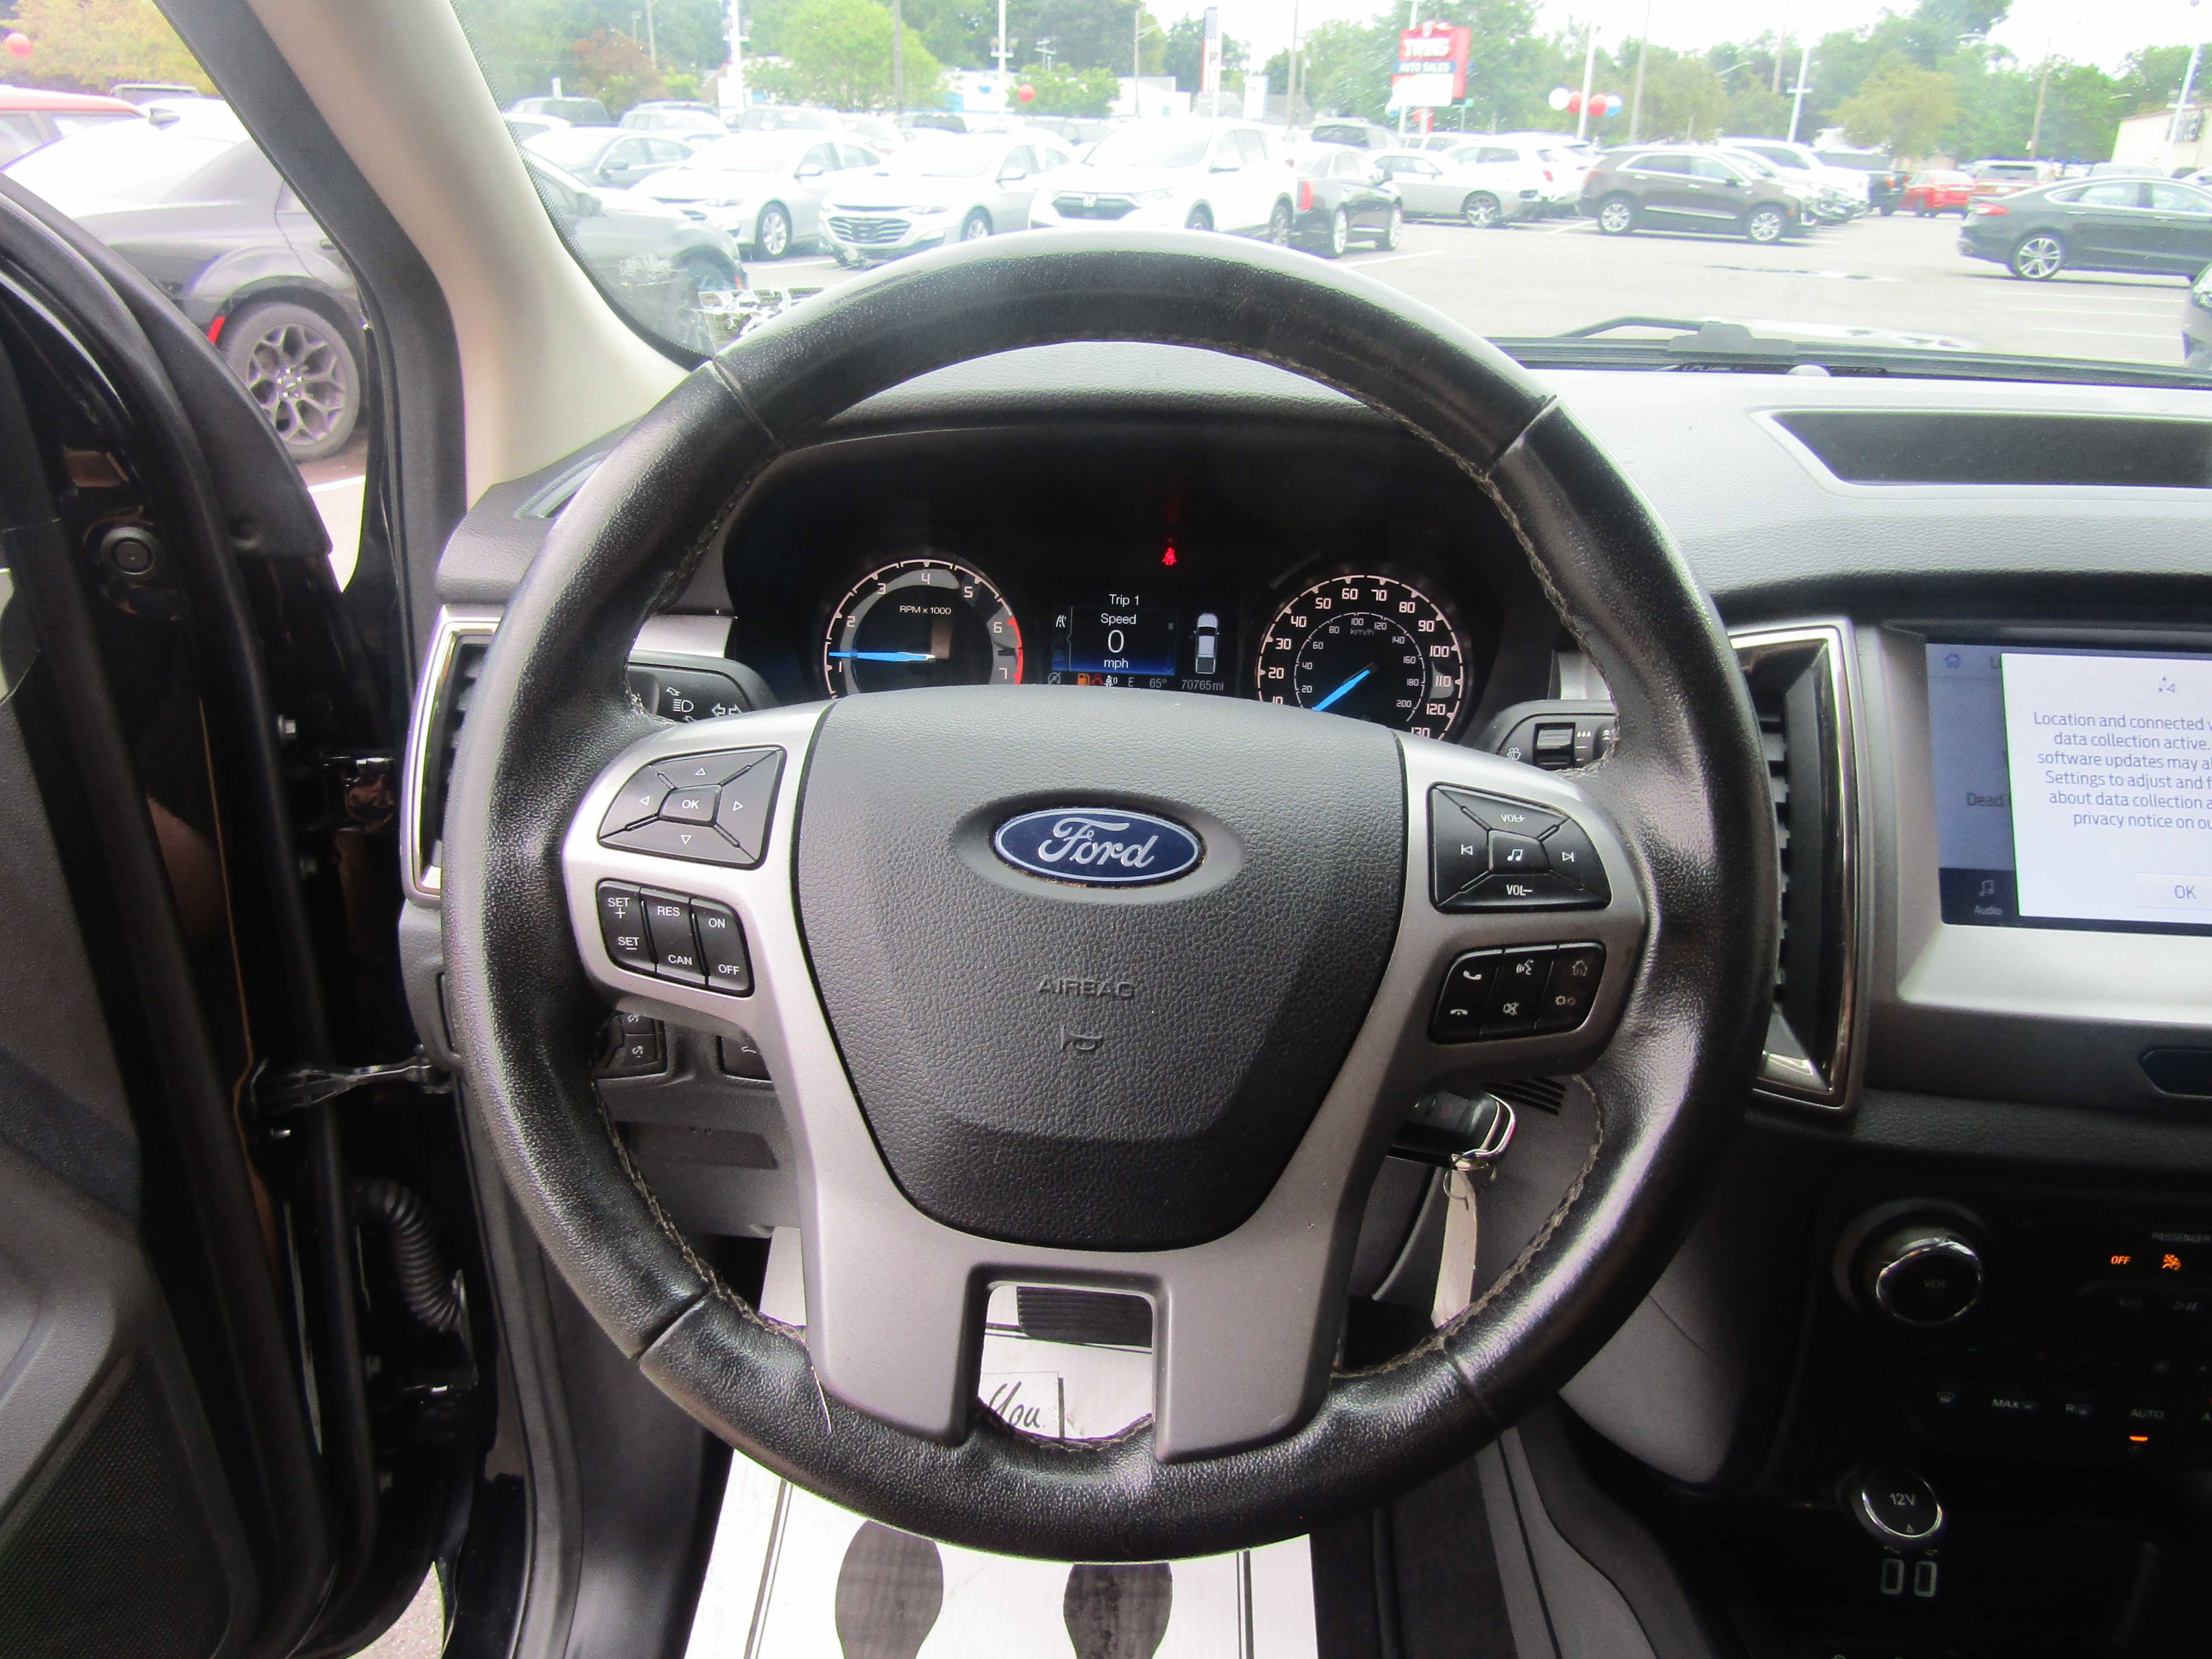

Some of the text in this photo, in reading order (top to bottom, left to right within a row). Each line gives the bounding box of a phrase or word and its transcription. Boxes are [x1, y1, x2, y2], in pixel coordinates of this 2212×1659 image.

[922, 573, 930, 585] 4
[877, 583, 886, 595] 3
[964, 586, 973, 598] 5
[1342, 588, 1358, 600] 60
[1371, 589, 1387, 601] 70
[1109, 594, 1139, 607] Trip 1
[1315, 598, 1331, 610] 50
[900, 605, 921, 614] RPM
[930, 607, 951, 615] 1000
[1399, 602, 1415, 614] 80
[846, 616, 855, 627] 2
[1100, 613, 1136, 626] Speed
[1291, 616, 1307, 628] 40
[994, 622, 1002, 633] 6
[1350, 628, 1374, 636] km/h
[1418, 620, 1435, 632] 90
[1108, 629, 1124, 653] 0
[1275, 638, 1291, 650] 30
[1429, 645, 1449, 657] 100
[839, 661, 842, 673] 1
[1104, 658, 1128, 670] mph
[999, 668, 1008, 679] 7
[1268, 667, 1284, 679] 20
[1128, 678, 1134, 687] E
[1435, 675, 1451, 687] 110
[1426, 703, 1446, 715] 120
[2033, 711, 2096, 726] Location
[2099, 714, 2126, 728] and
[2130, 717, 2203, 731] connected
[1411, 727, 1430, 738] 130
[2054, 732, 2211, 750] data collection active.
[2038, 751, 2102, 766] software
[2105, 754, 2164, 769] updates
[2167, 758, 2198, 772] may
[2045, 771, 2106, 788] Settings
[2109, 774, 2124, 787] to
[2127, 775, 2172, 791] adjust
[2176, 776, 2203, 790] and
[682, 799, 700, 810] OK
[1966, 793, 2004, 807] Dead
[2049, 791, 2092, 805] about
[2095, 793, 2129, 807] data
[2133, 794, 2203, 809] collection
[2073, 813, 2124, 829] privacy
[2128, 814, 2172, 829] notice
[2176, 817, 2194, 829] on
[1038, 817, 1158, 868] Ford
[2174, 885, 2197, 899] OK
[608, 897, 630, 908] SET
[657, 906, 681, 917] RES
[708, 918, 725, 929] ON
[618, 936, 639, 946] SET
[668, 954, 693, 966] CAN
[718, 964, 740, 975] OFF
[1037, 977, 1135, 1000] AIRBAG
[2110, 1255, 2132, 1265] OFF
[988, 1381, 1040, 1428] You
[1992, 1398, 2019, 1410] MAX
[2130, 1409, 2164, 1419] AUTO
[1890, 1492, 1915, 1506] 12V
